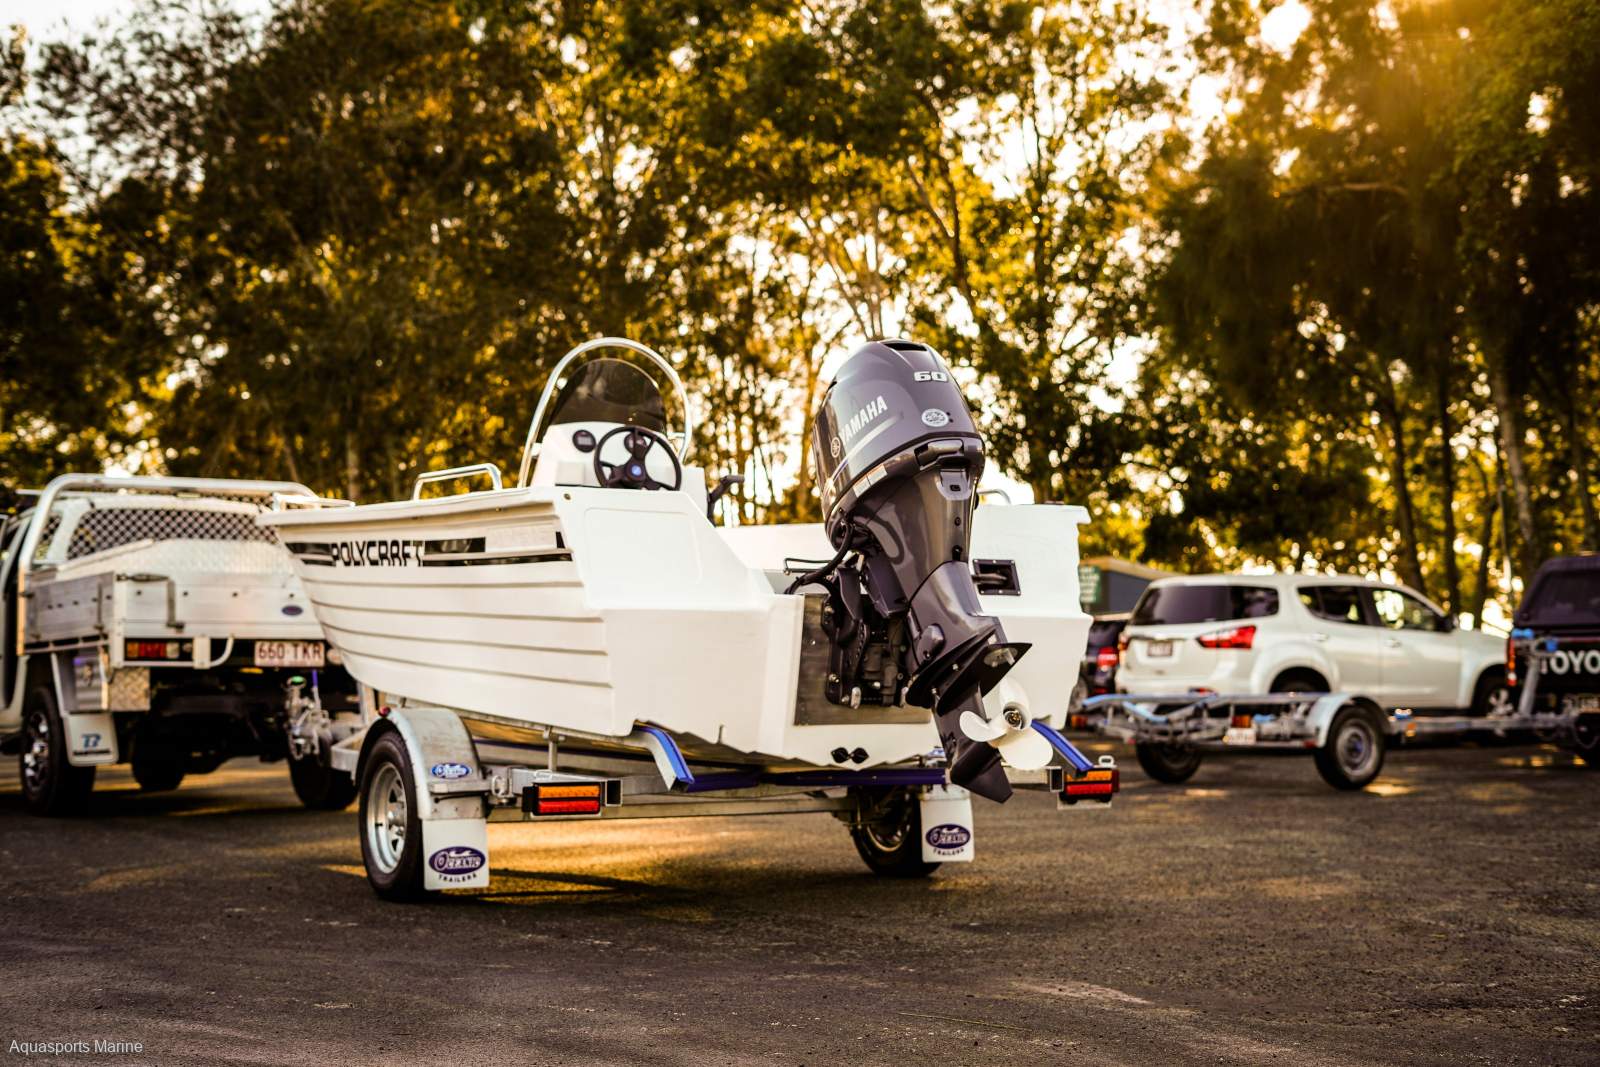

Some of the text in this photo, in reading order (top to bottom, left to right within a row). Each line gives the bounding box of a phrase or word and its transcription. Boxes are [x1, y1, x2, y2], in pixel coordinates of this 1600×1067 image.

[913, 370, 948, 382] 60
[838, 395, 888, 446] YAMAHA
[331, 540, 425, 567] POLYCRAFT
